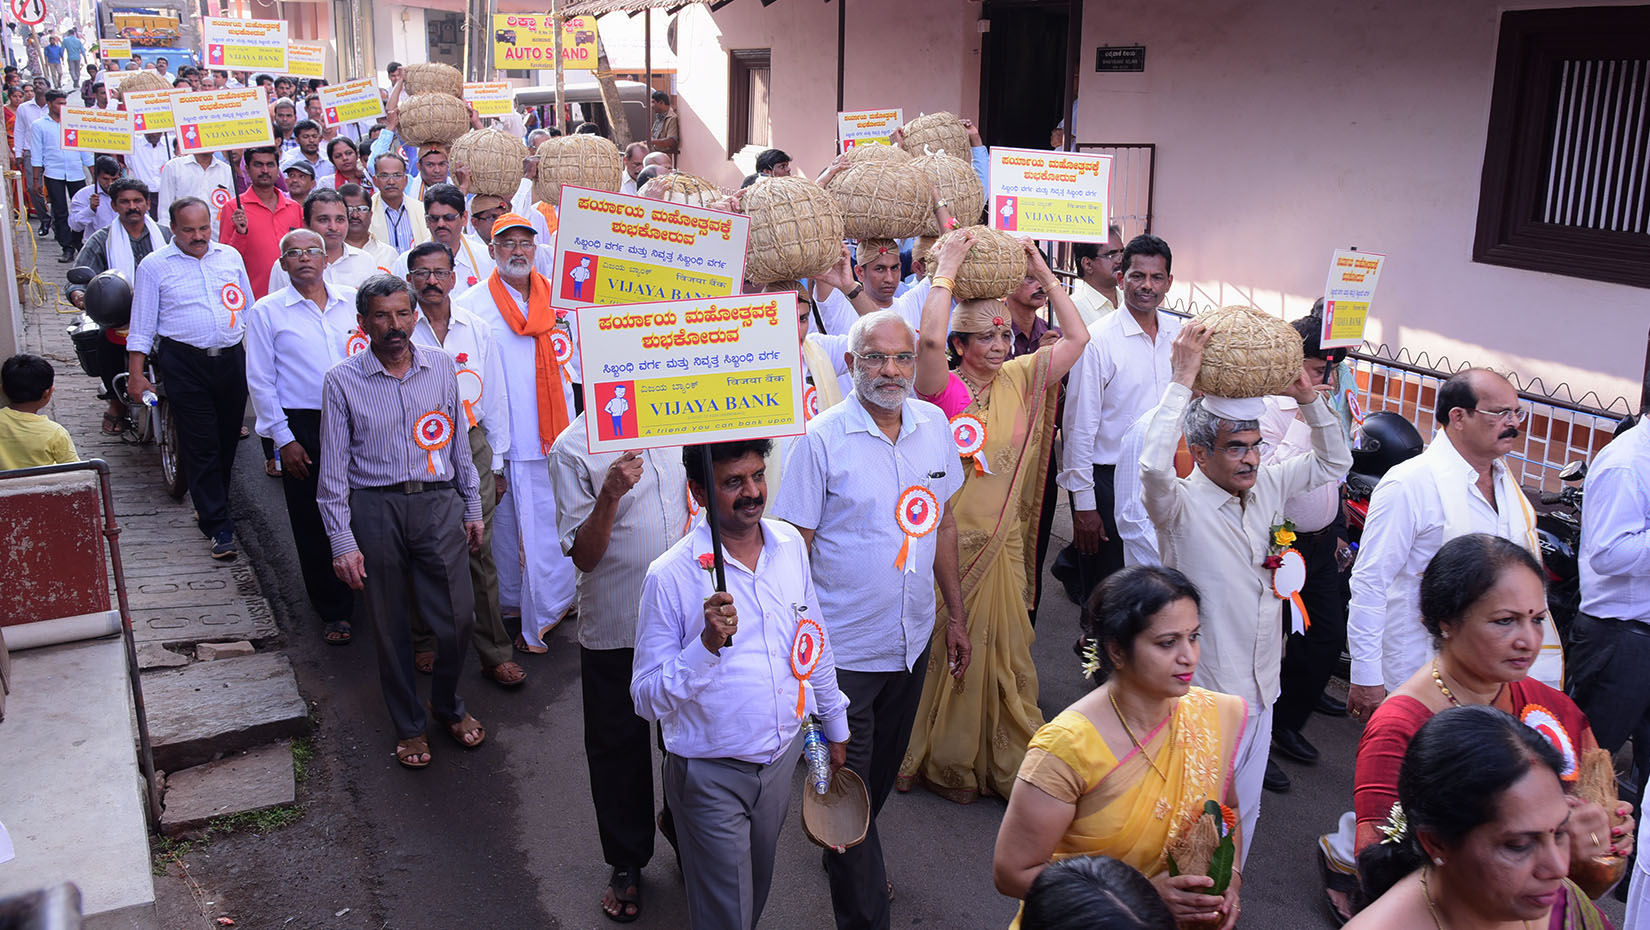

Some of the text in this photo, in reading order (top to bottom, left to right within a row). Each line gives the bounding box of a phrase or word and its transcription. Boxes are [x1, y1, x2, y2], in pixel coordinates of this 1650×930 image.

[505, 47, 588, 59] AUTO SAND
[205, 128, 262, 139] VIJAYA BANK
[578, 196, 733, 241] ಪರ್ಯಾಯ ಮಹೋತ್ಸವಕ್ಕೆ
[1025, 211, 1095, 224] VIJAYA BANK
[611, 220, 696, 246] ಶುಭಕೋರುವ
[604, 240, 624, 252] ವರ್ಗ
[628, 244, 648, 258] ಮತ್ತು
[707, 258, 727, 269] ವರ್ಗ
[608, 278, 711, 300] VIJAYA BA
[599, 300, 778, 330] ಪರ್ಯಾಯ ಮಹೋತ್ಸವಕ್ಕೆ
[642, 326, 740, 350] ಶುಭಕೋರುವ
[639, 360, 662, 371] ವರ್ಗ
[666, 357, 689, 370] ಮತ್ತು
[694, 354, 720, 368] ನಿವೃತ್ತ
[758, 350, 780, 361] ವರ್ಗ
[650, 398, 720, 416] VIJAYA
[726, 392, 780, 411] BANK
[656, 426, 687, 434] friend
[691, 424, 710, 432] you
[738, 419, 762, 427] bank
[767, 417, 793, 425] upon
